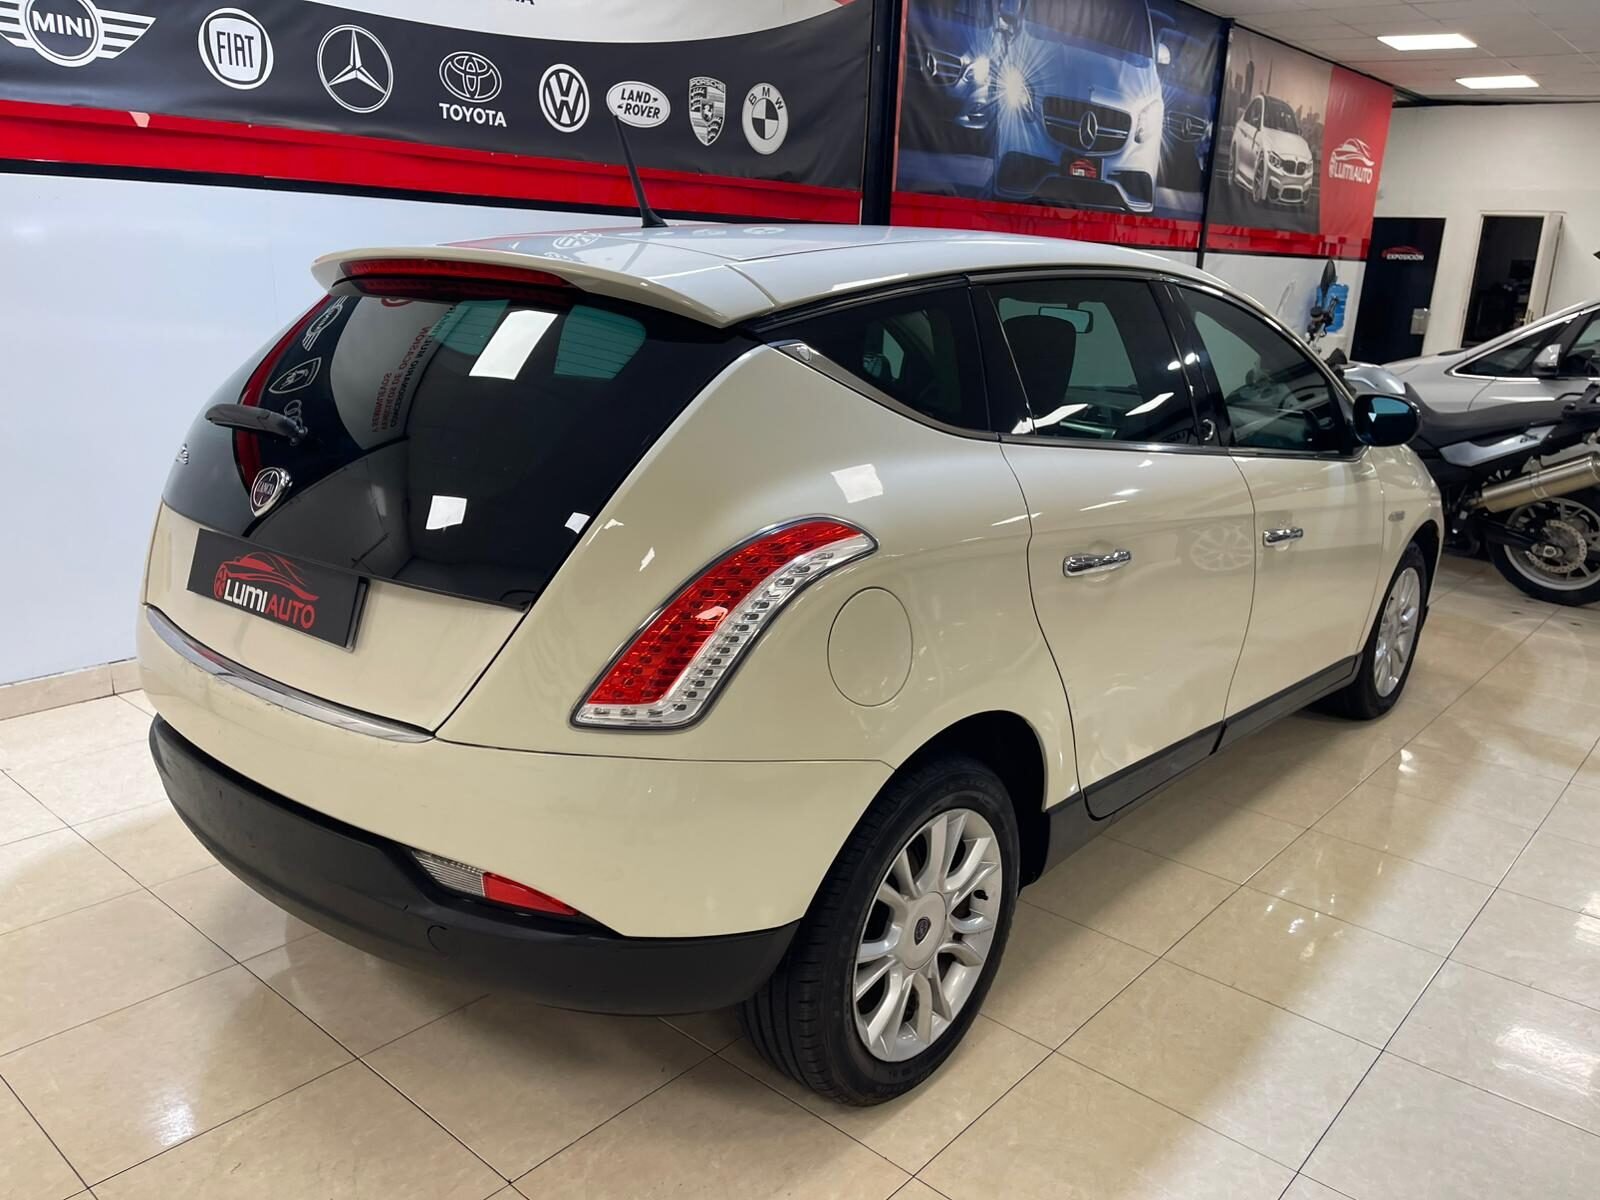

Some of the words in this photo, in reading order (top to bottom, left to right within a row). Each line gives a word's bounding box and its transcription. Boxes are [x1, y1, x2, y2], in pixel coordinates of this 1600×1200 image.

[32, 10, 92, 39] MINI
[216, 30, 255, 69] FIAT
[620, 88, 652, 104] LAND
[748, 86, 784, 110] BMW
[438, 102, 508, 128] TOYOTA
[624, 103, 661, 119] ROVER
[1333, 161, 1374, 185] LUMIAUTO
[223, 579, 315, 629] LUMIAUTO
